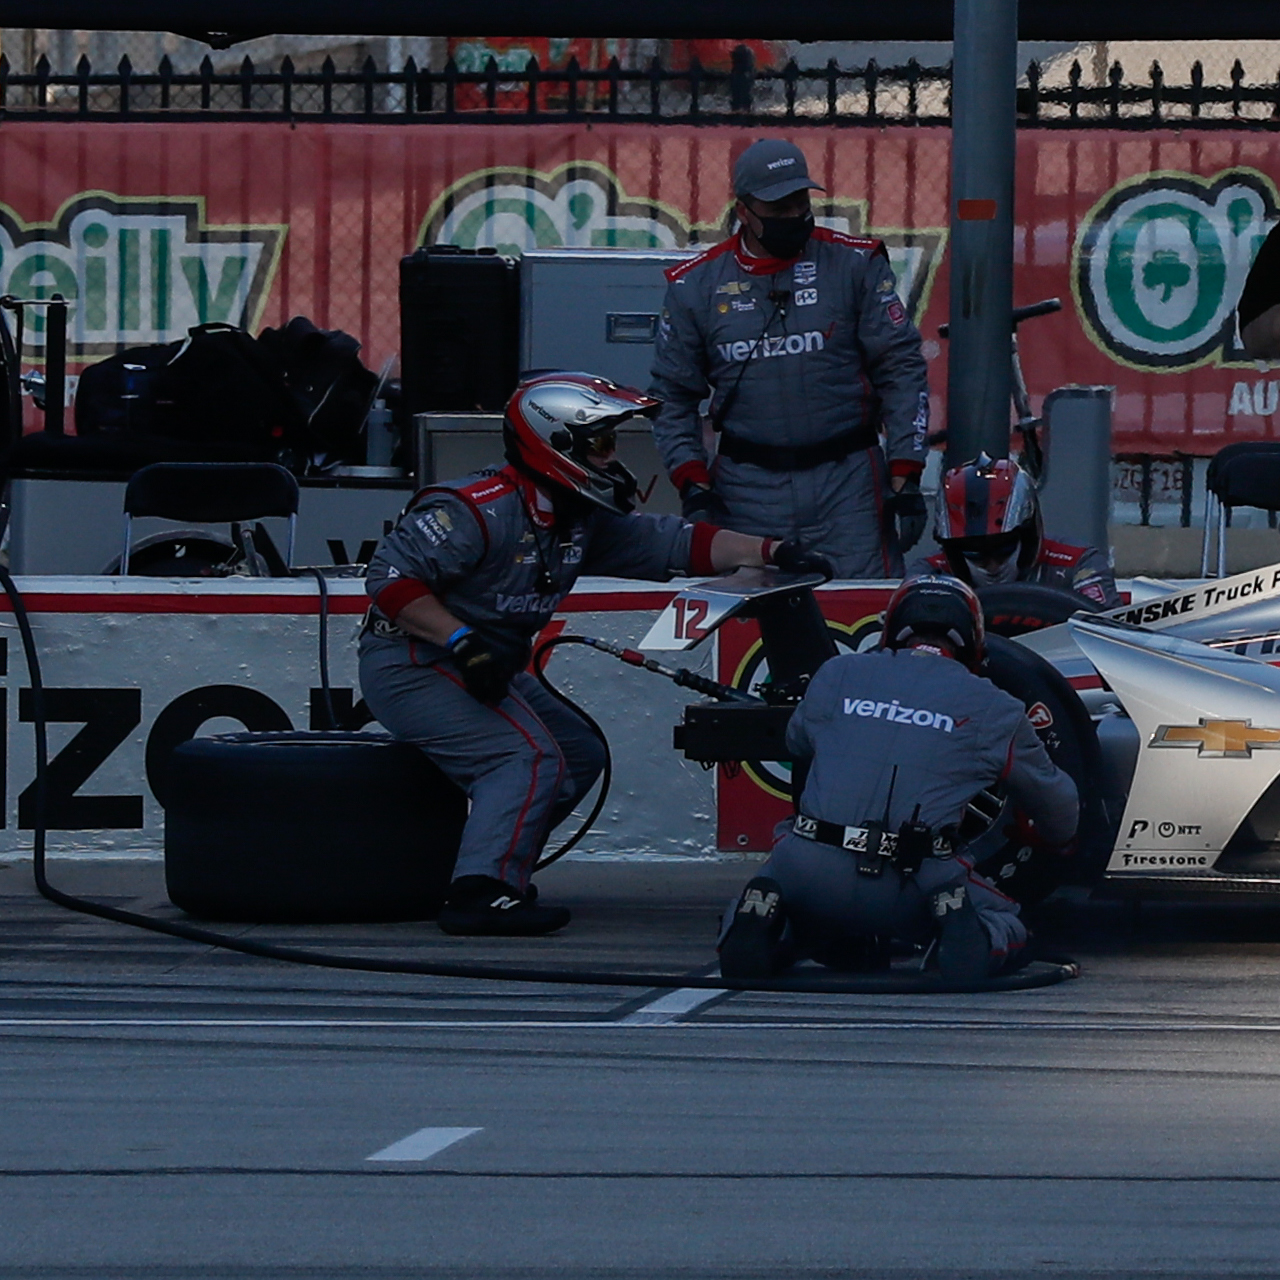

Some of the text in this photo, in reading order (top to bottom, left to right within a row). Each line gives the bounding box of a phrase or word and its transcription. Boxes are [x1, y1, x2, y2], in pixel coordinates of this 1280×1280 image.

[716, 330, 825, 363] verizon
[1228, 380, 1280, 416] AU
[1112, 593, 1197, 625] ENSKE
[1203, 575, 1264, 608] Truck
[672, 597, 710, 640] 12
[843, 697, 956, 734] verizon
[1176, 824, 1202, 836] NTT
[1122, 853, 1208, 867] Firestone
